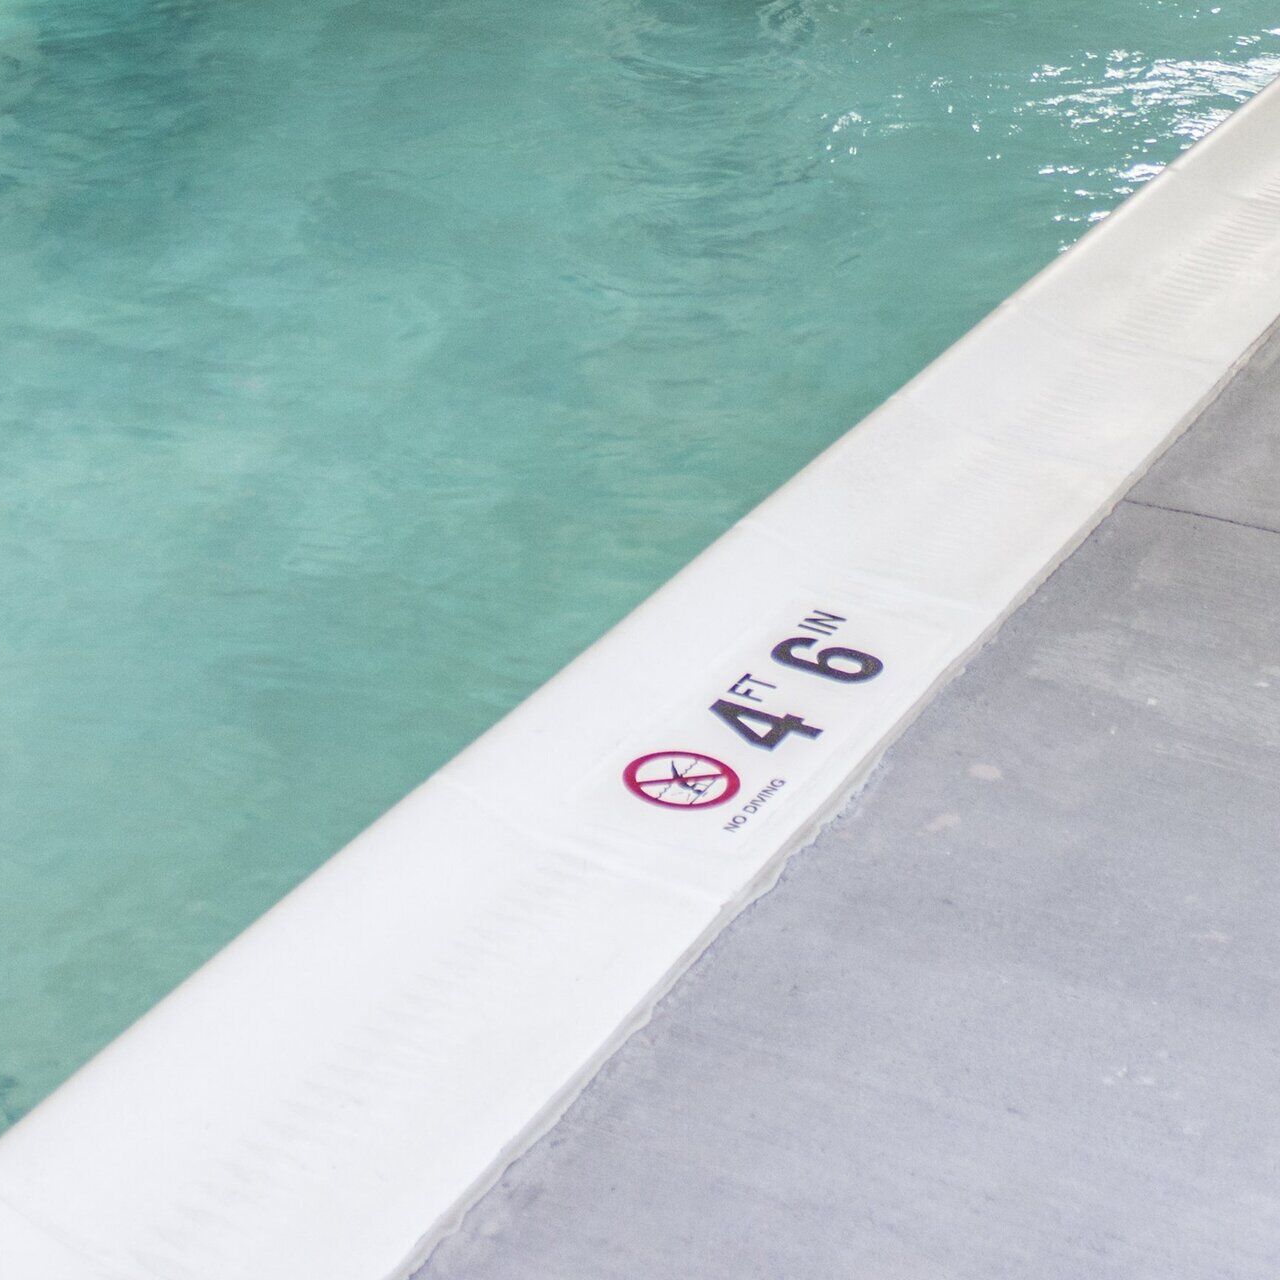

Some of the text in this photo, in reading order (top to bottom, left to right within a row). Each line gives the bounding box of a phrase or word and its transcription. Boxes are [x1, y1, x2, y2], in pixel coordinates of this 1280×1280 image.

[709, 699, 824, 751] 4
[770, 637, 884, 684] 6
[723, 777, 786, 833] NO DIVING
